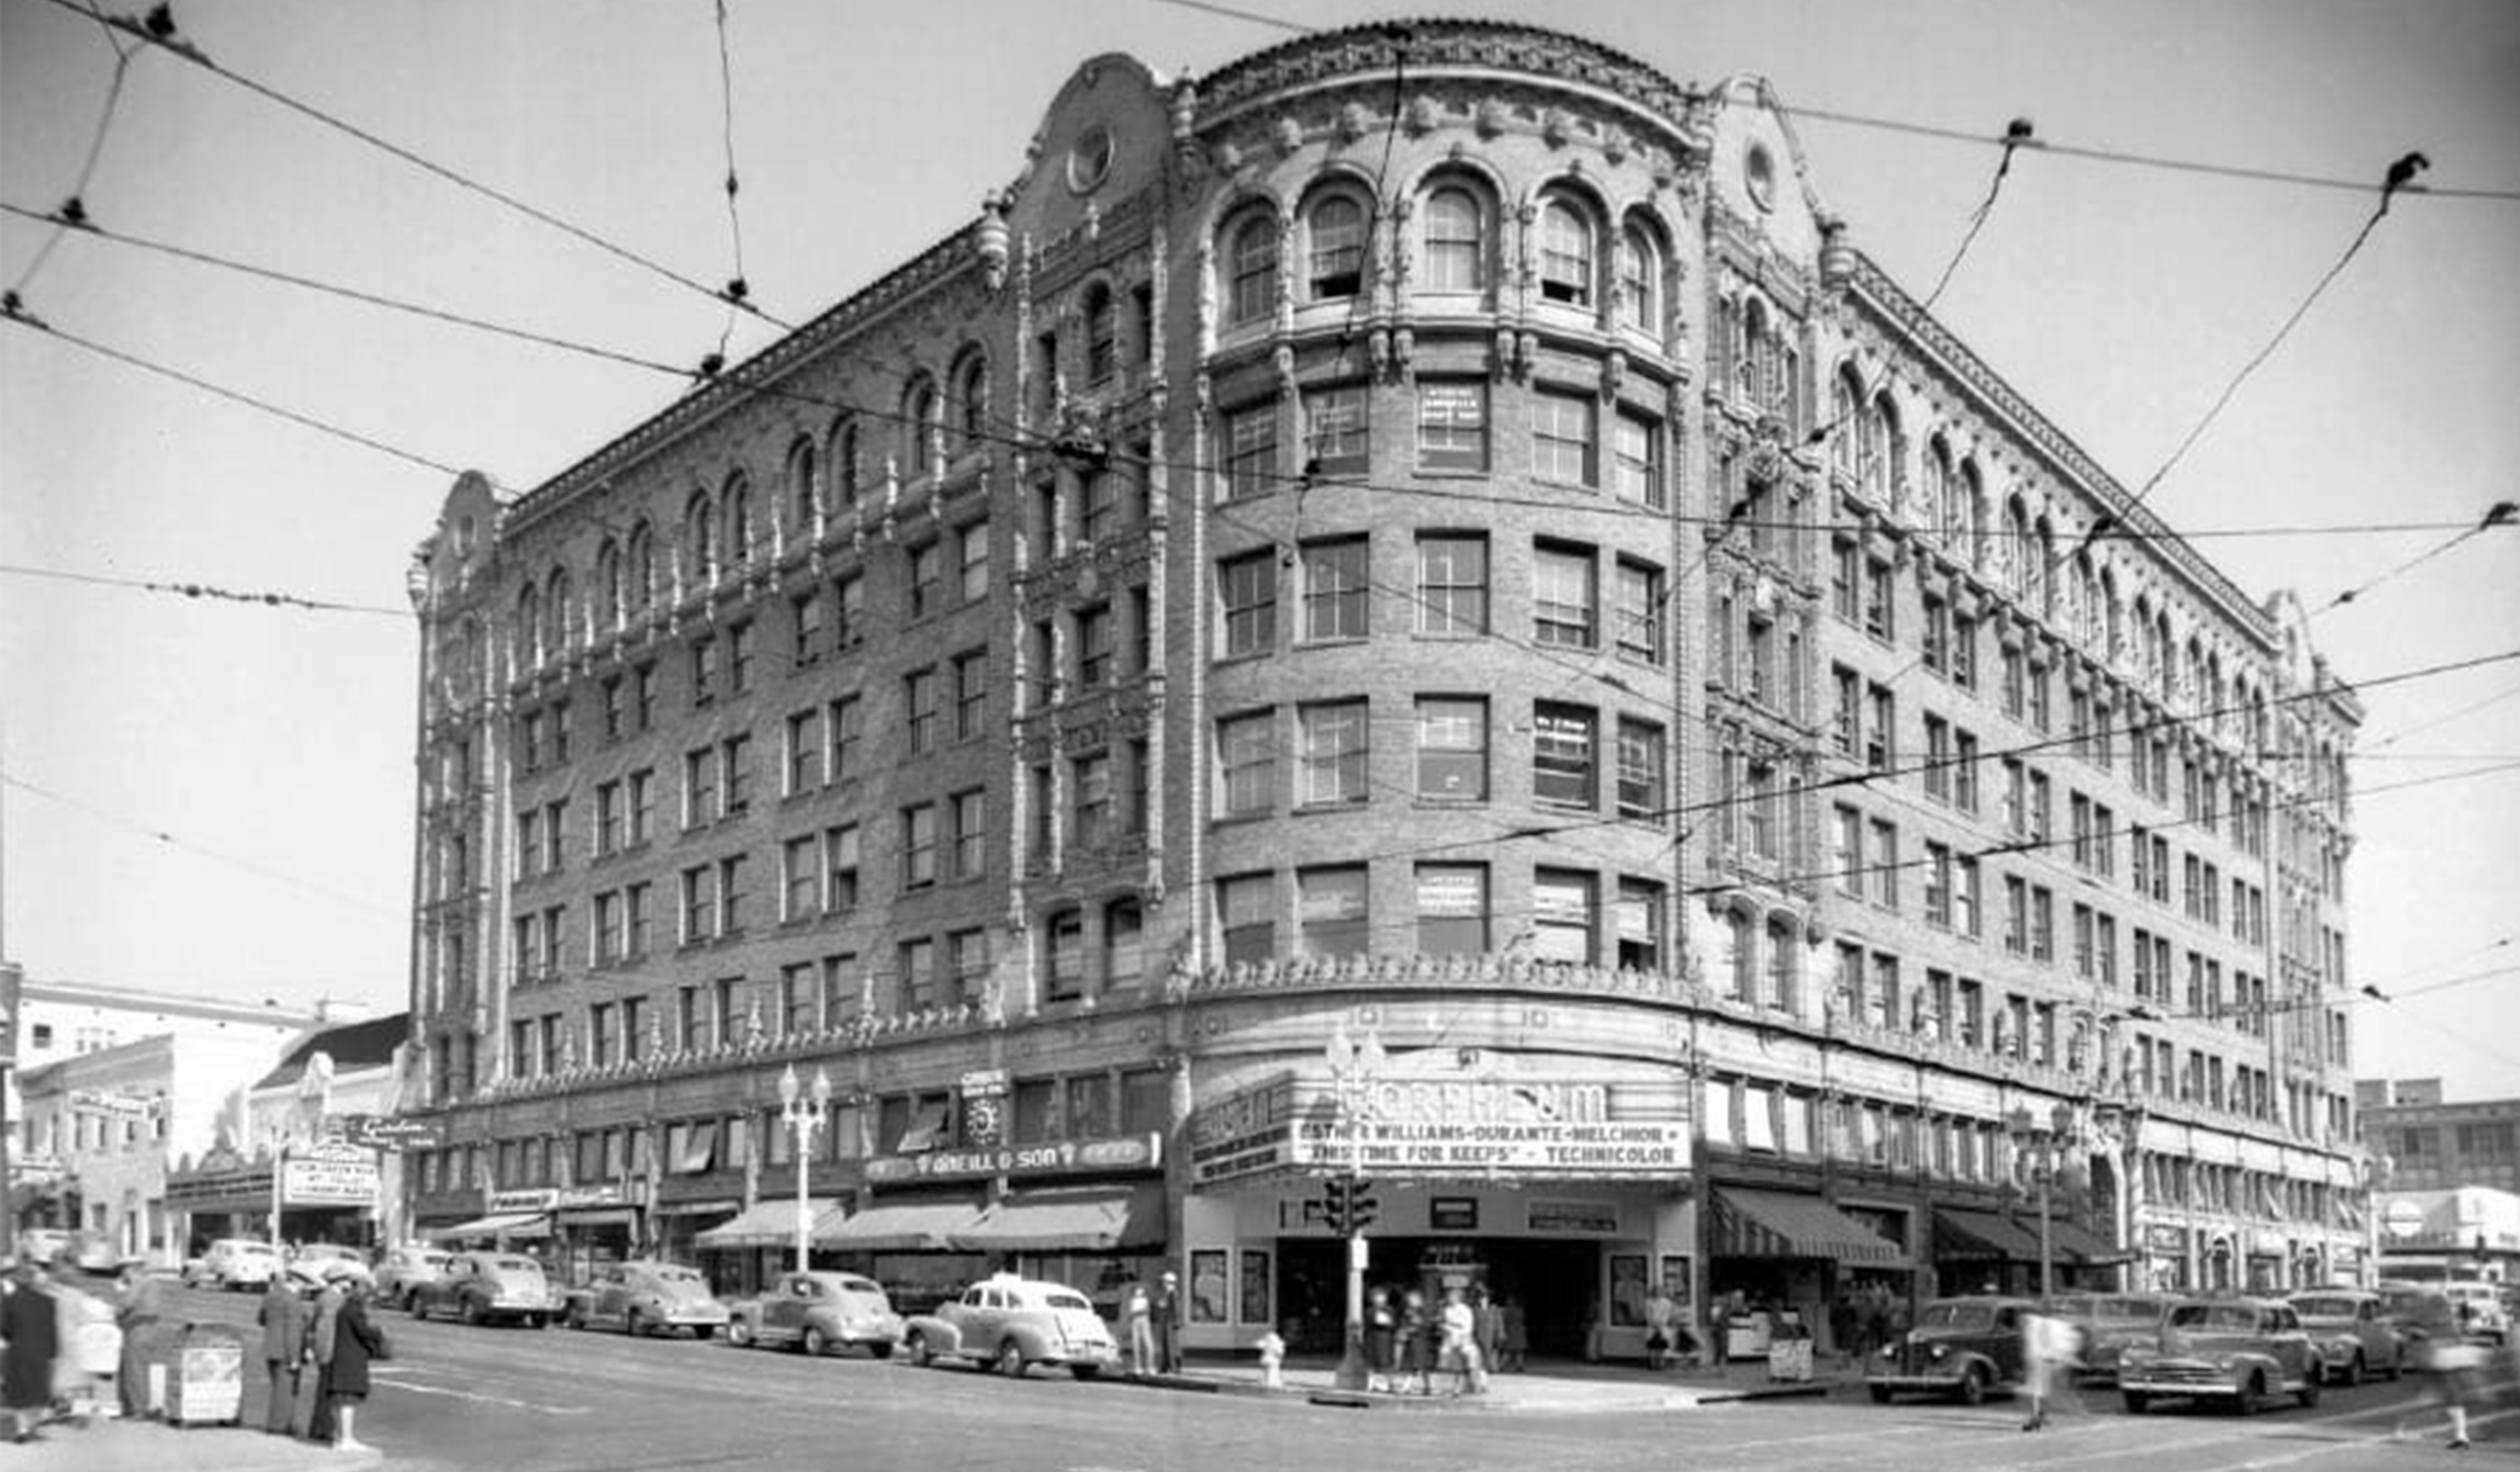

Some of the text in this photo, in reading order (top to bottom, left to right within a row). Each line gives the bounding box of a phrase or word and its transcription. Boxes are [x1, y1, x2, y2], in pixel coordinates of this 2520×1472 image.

[1017, 1148, 1057, 1168] SON
[1407, 1146, 1443, 1162] FOR
[1546, 1147, 1675, 1164] TECHNICOLOR
